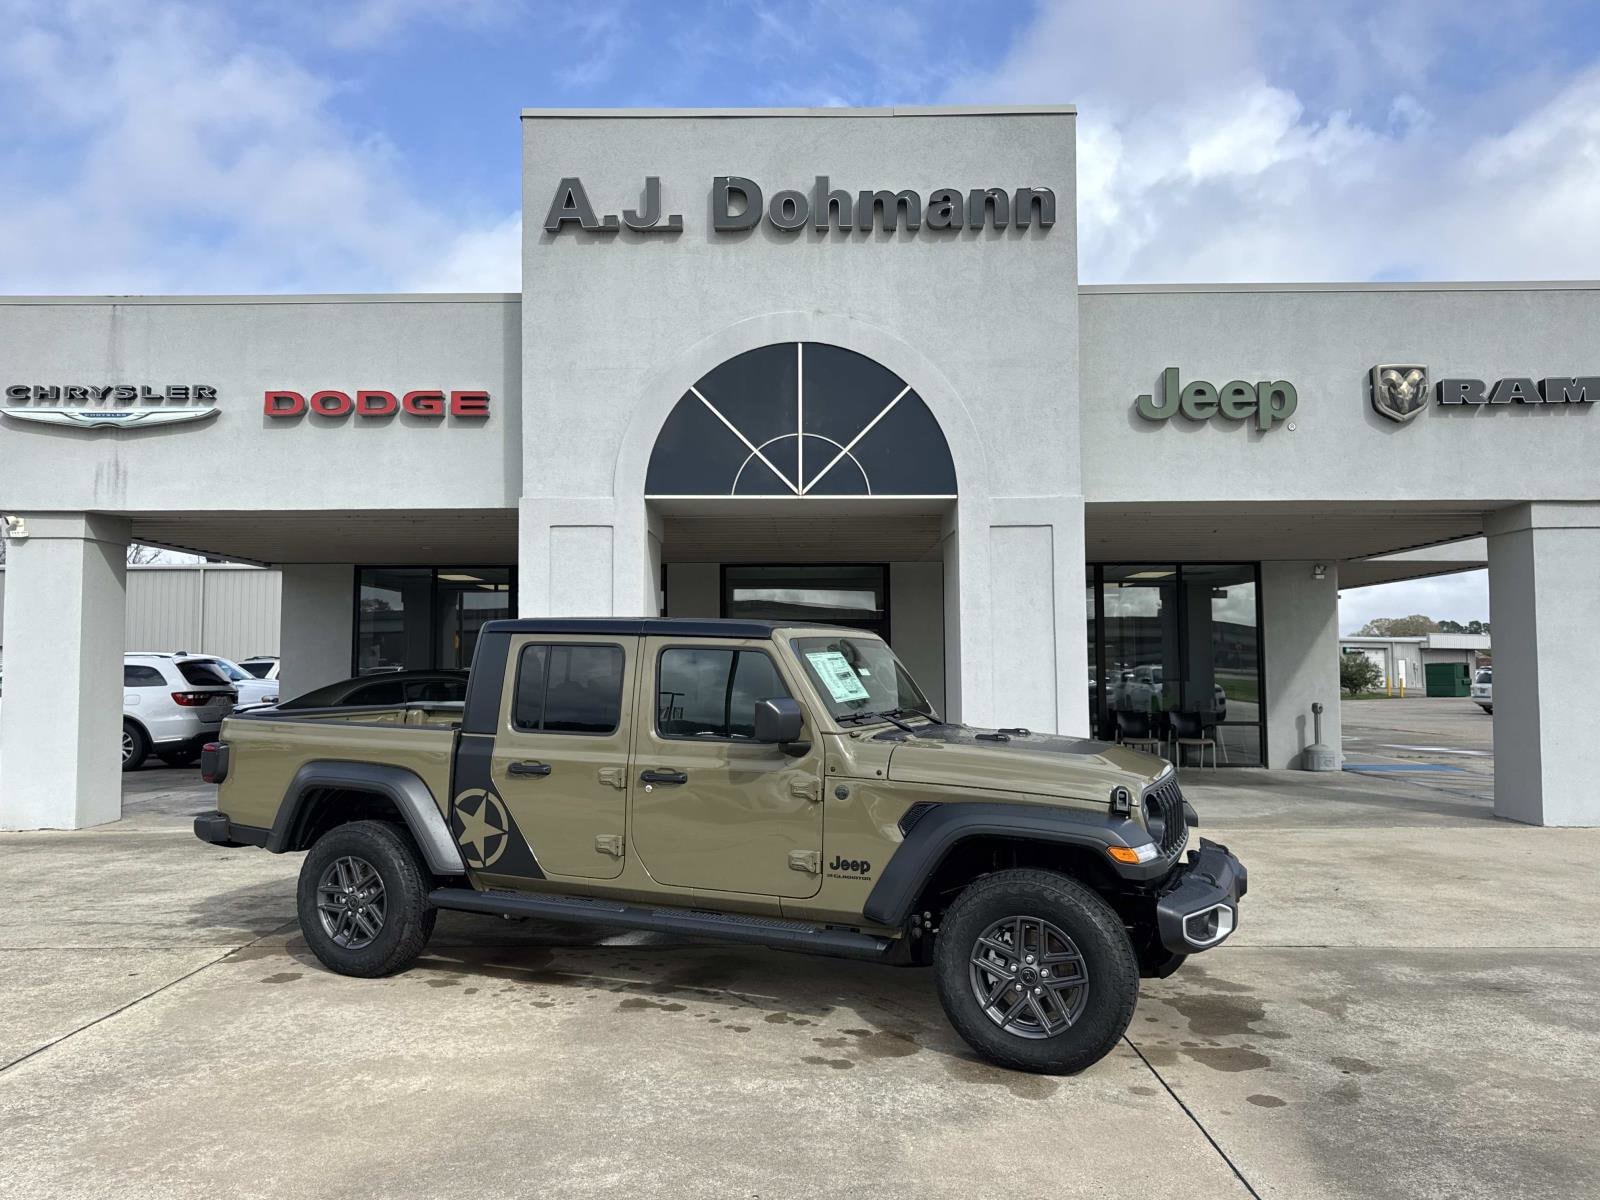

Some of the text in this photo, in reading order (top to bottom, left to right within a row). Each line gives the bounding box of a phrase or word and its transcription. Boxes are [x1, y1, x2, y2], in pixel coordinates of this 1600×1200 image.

[543, 176, 1057, 234] A.J. Dohmann
[5, 384, 218, 402] CHRYSLER
[263, 390, 491, 419] DODGE
[1136, 367, 1298, 431] Jeep
[1437, 376, 1600, 406] RAM
[829, 855, 871, 874] Jeep
